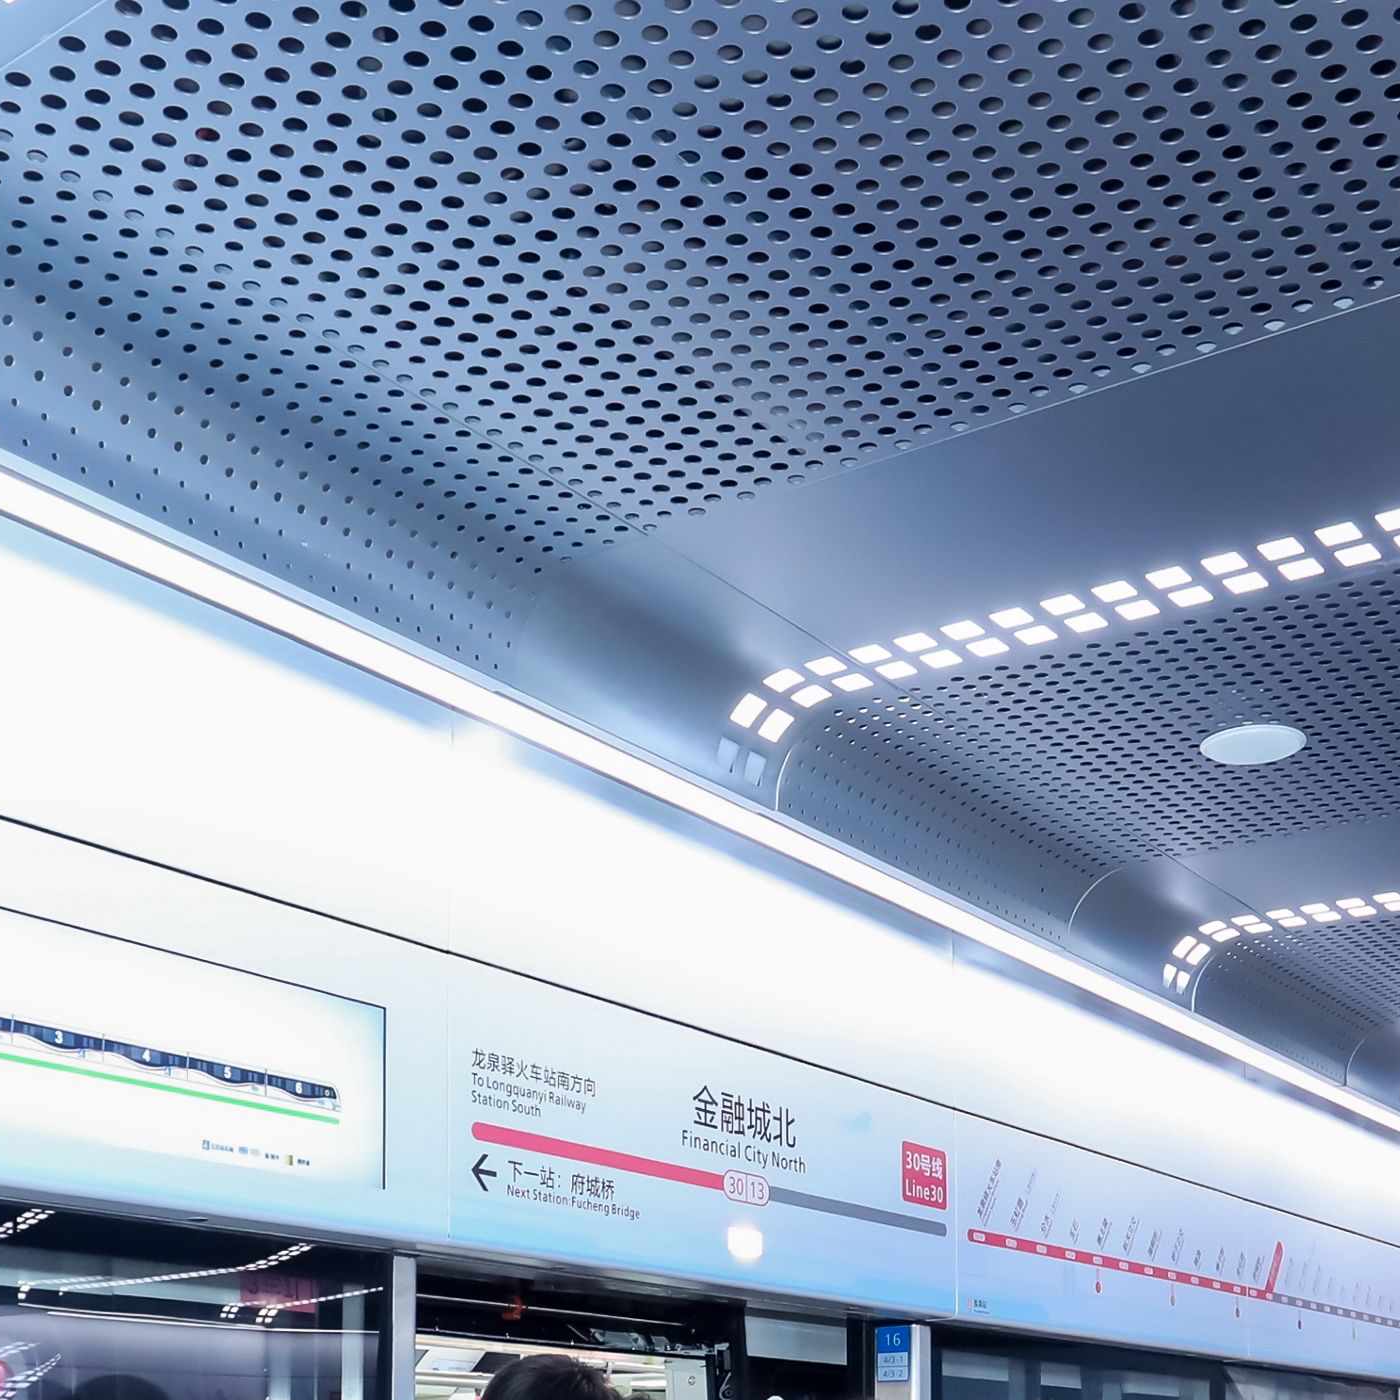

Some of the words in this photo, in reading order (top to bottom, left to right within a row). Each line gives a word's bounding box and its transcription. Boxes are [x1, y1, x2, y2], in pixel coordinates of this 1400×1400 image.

[55, 1030, 64, 1044] 3
[142, 1049, 151, 1062] 4
[223, 1066, 232, 1079] 5
[295, 1082, 303, 1095] 6
[471, 1048, 596, 1097] 龙泉驿火车站南方向
[471, 1072, 484, 1087] To
[486, 1075, 547, 1104] Longquanyi
[548, 1092, 587, 1114] Railway
[471, 1090, 509, 1111] Station
[511, 1099, 542, 1118] South
[692, 1085, 796, 1148] 金融城北
[682, 1129, 741, 1159] Financial
[744, 1145, 768, 1169] City
[772, 1151, 807, 1174] North
[905, 1151, 943, 1179] 30号线
[507, 1184, 530, 1200] Next
[611, 1203, 641, 1221] Bridge
[729, 1176, 744, 1195] 30
[750, 1181, 765, 1200] 13
[905, 1178, 944, 1203] Line30
[886, 1333, 901, 1346] 16
